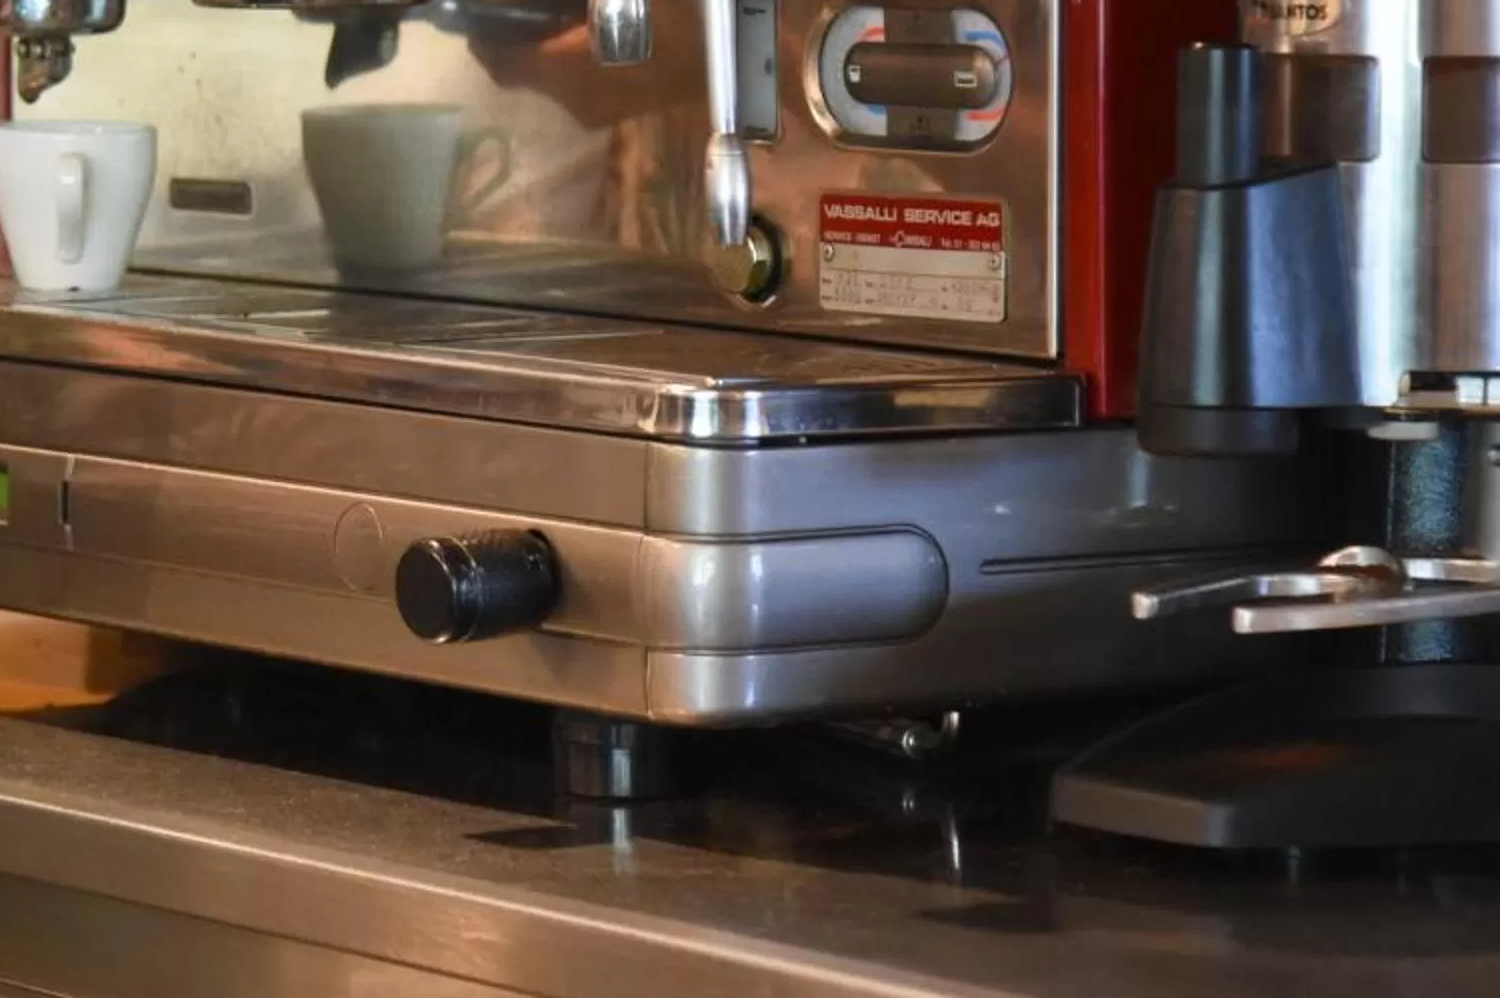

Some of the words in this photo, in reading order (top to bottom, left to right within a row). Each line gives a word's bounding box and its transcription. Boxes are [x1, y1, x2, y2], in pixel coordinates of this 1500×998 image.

[823, 203, 897, 222] VASSALLI
[903, 207, 973, 226] SERVICE
[976, 211, 1000, 228] AG
